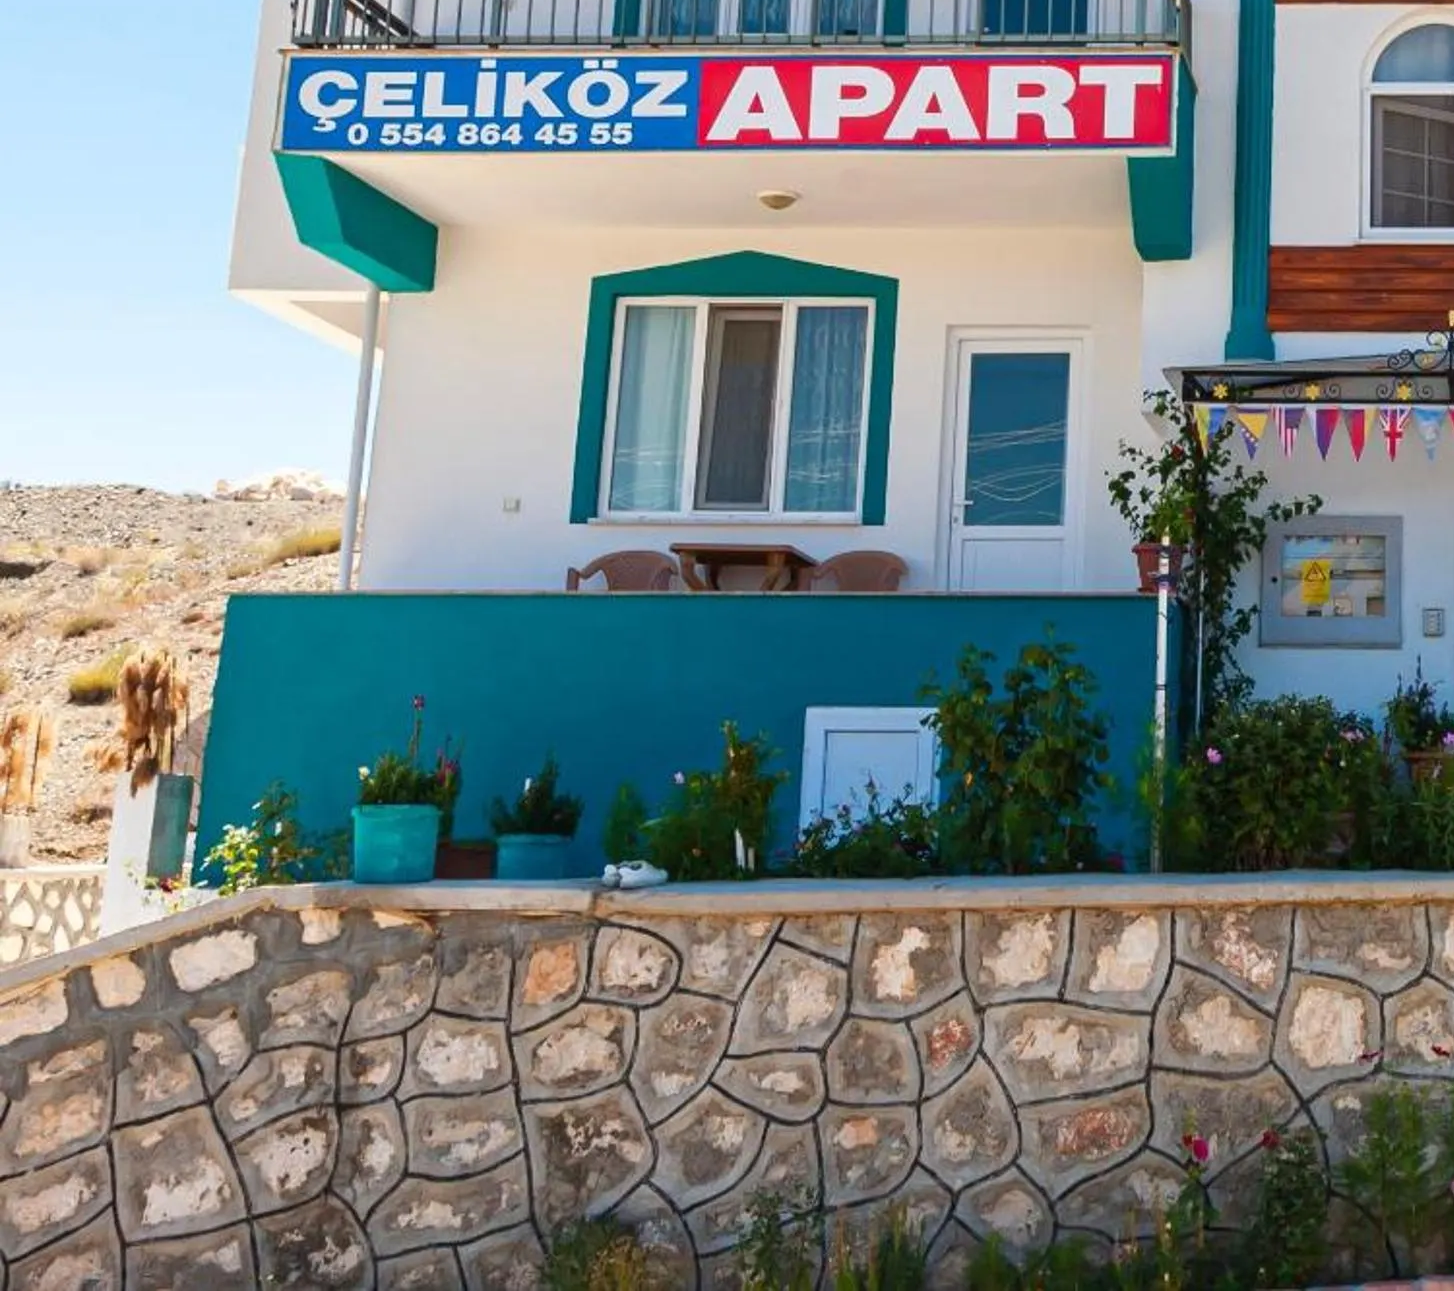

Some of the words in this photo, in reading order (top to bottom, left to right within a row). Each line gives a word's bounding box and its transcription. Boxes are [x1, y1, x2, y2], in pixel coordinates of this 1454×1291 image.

[299, 59, 688, 131] ÇELİKÖZ
[707, 66, 1162, 140] APART
[348, 123, 369, 145] 0
[380, 123, 446, 145] 554
[458, 123, 522, 145] 864
[535, 123, 577, 145] 45
[590, 123, 632, 145] 55
